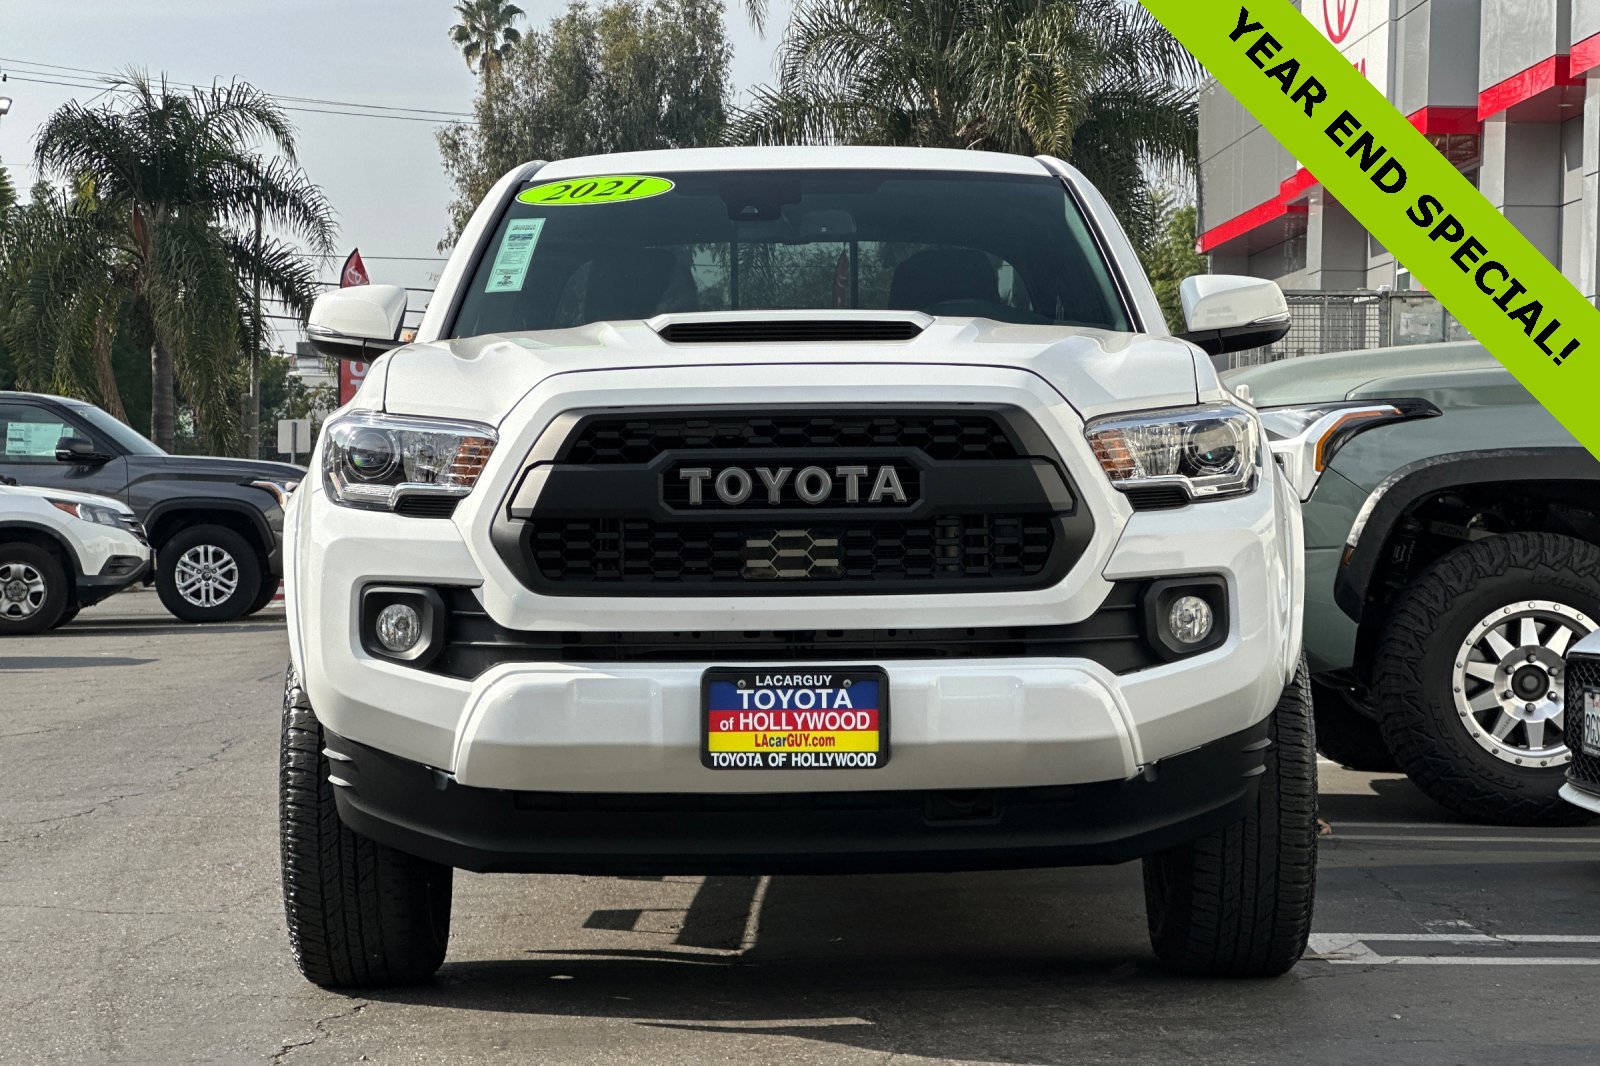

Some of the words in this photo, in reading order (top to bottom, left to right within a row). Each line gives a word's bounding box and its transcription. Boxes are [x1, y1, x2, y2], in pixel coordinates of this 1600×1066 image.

[541, 178, 647, 201] 2021
[679, 466, 907, 504] TOYOTA
[755, 675, 832, 687] LACARGUY
[736, 688, 853, 709] TOYOTA
[719, 717, 735, 731] of
[739, 711, 871, 731] HOLLYWOOD
[754, 733, 836, 748] LAcarGUY.com
[711, 752, 763, 767] TOYOTA
[768, 752, 787, 767] OF
[791, 752, 877, 767] HOLLYWOOD
